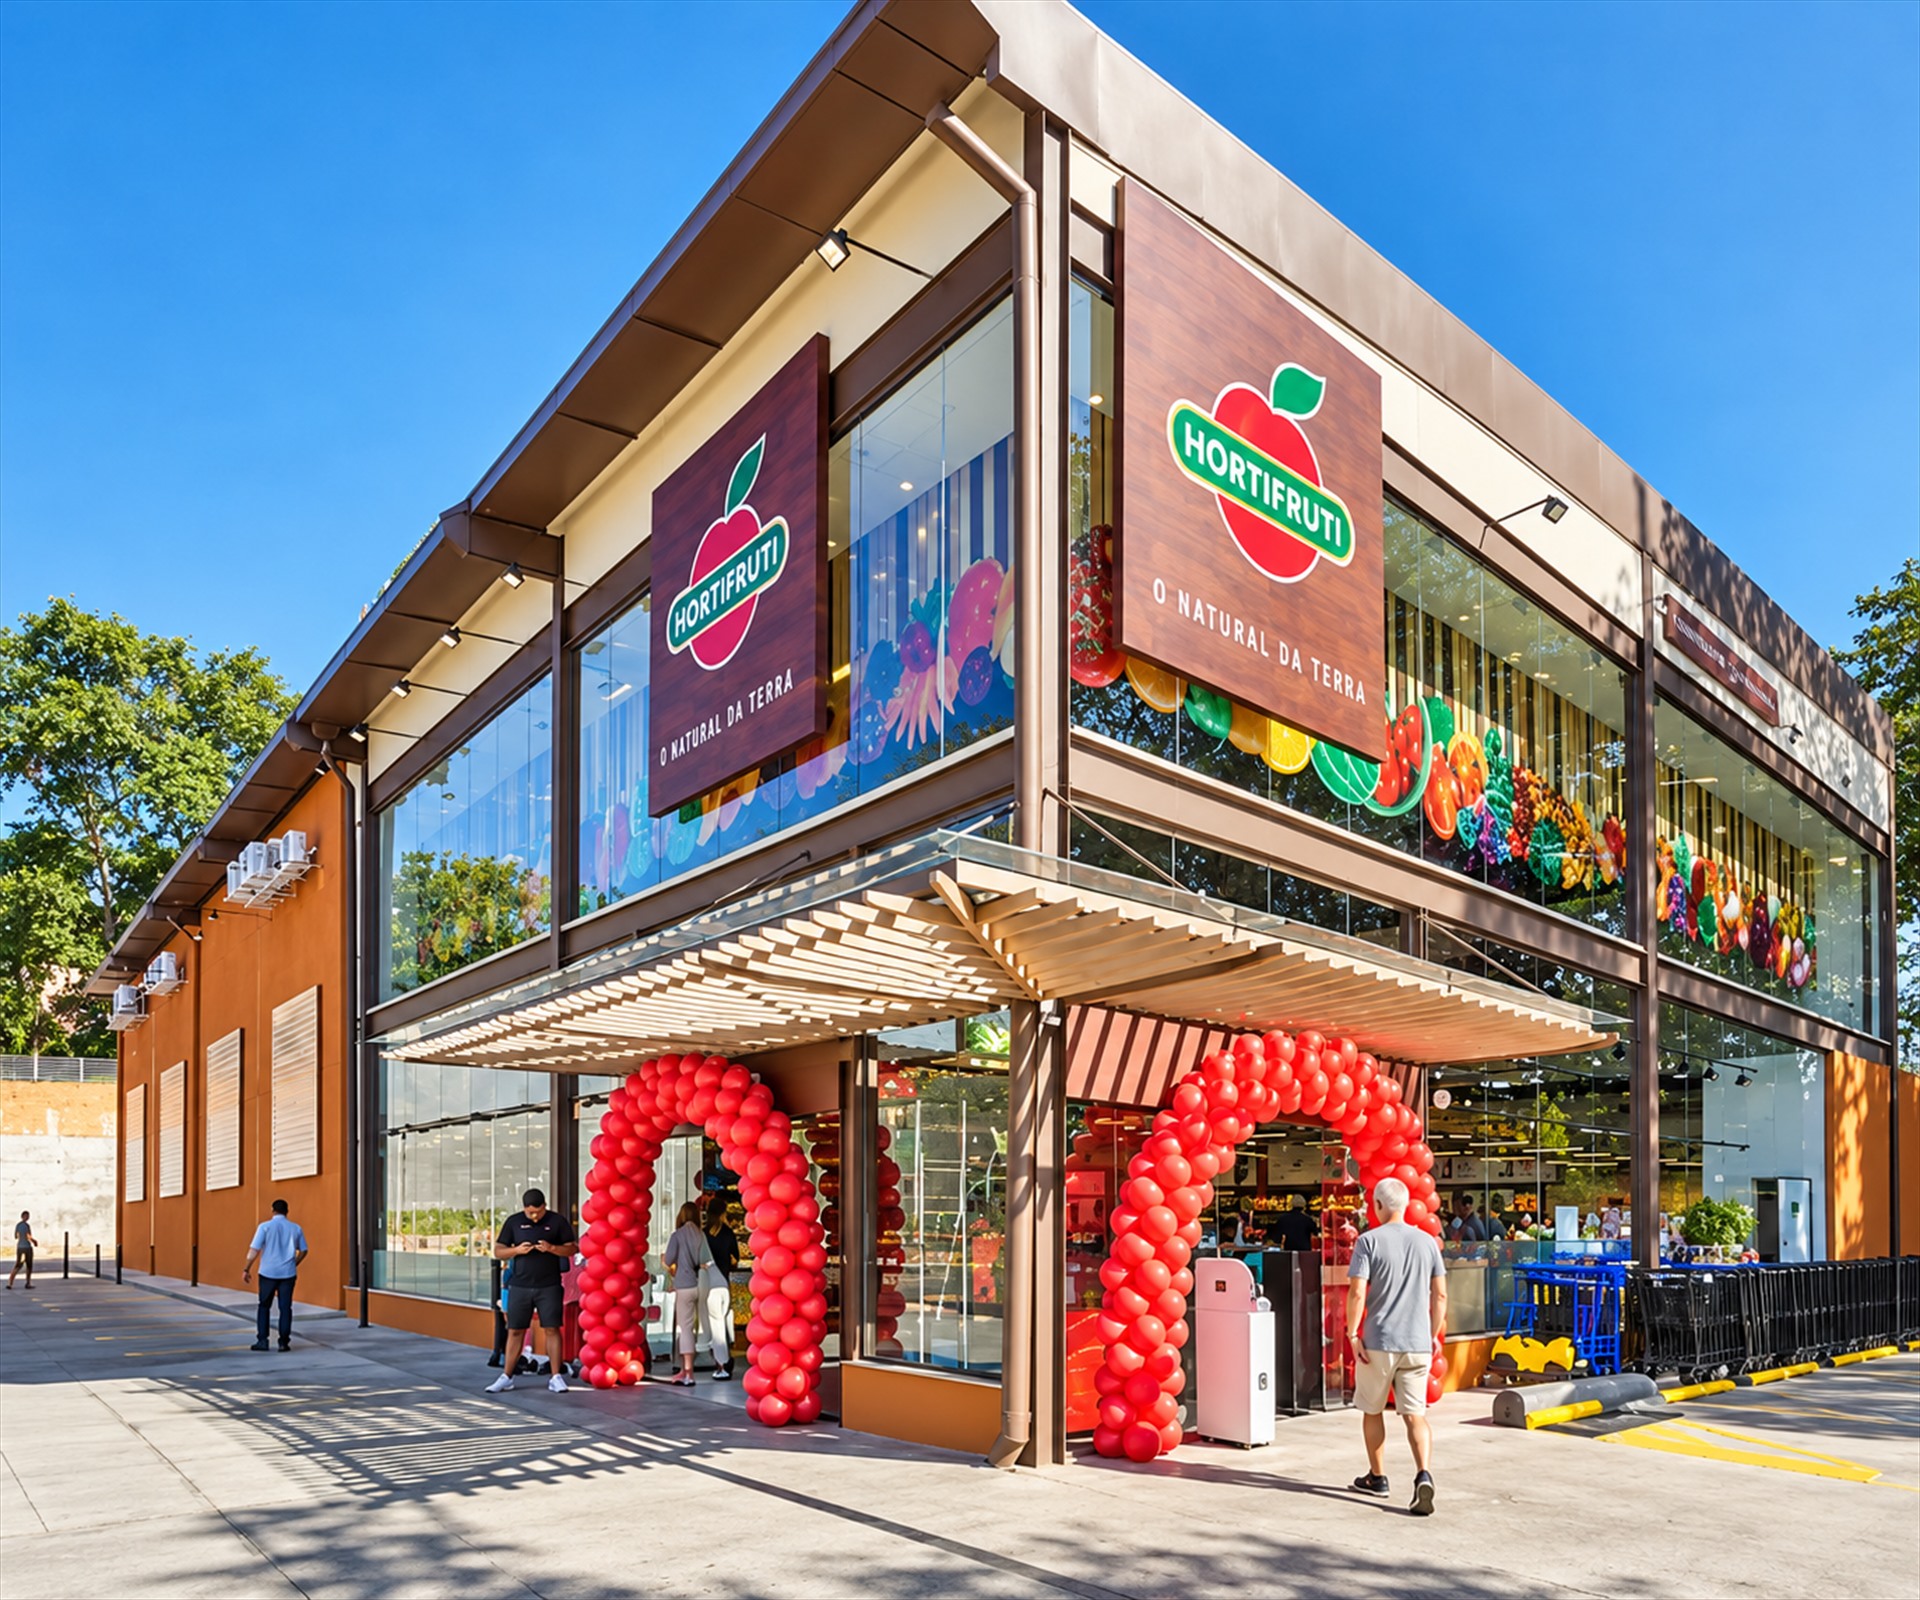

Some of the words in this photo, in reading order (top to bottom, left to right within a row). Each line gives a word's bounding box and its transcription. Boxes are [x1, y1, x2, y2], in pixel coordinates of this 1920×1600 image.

[1184, 421, 1342, 548] HORTIFRUTI
[674, 535, 779, 639] HORTIFRUTI
[1152, 576, 1167, 605] O
[1177, 588, 1270, 658] NATURAL
[1278, 639, 1303, 674] DA
[1310, 656, 1367, 705] TERRA
[659, 745, 668, 767] O
[671, 713, 723, 761] NATURAL
[727, 700, 743, 728] DA
[748, 667, 794, 714] TERRA
